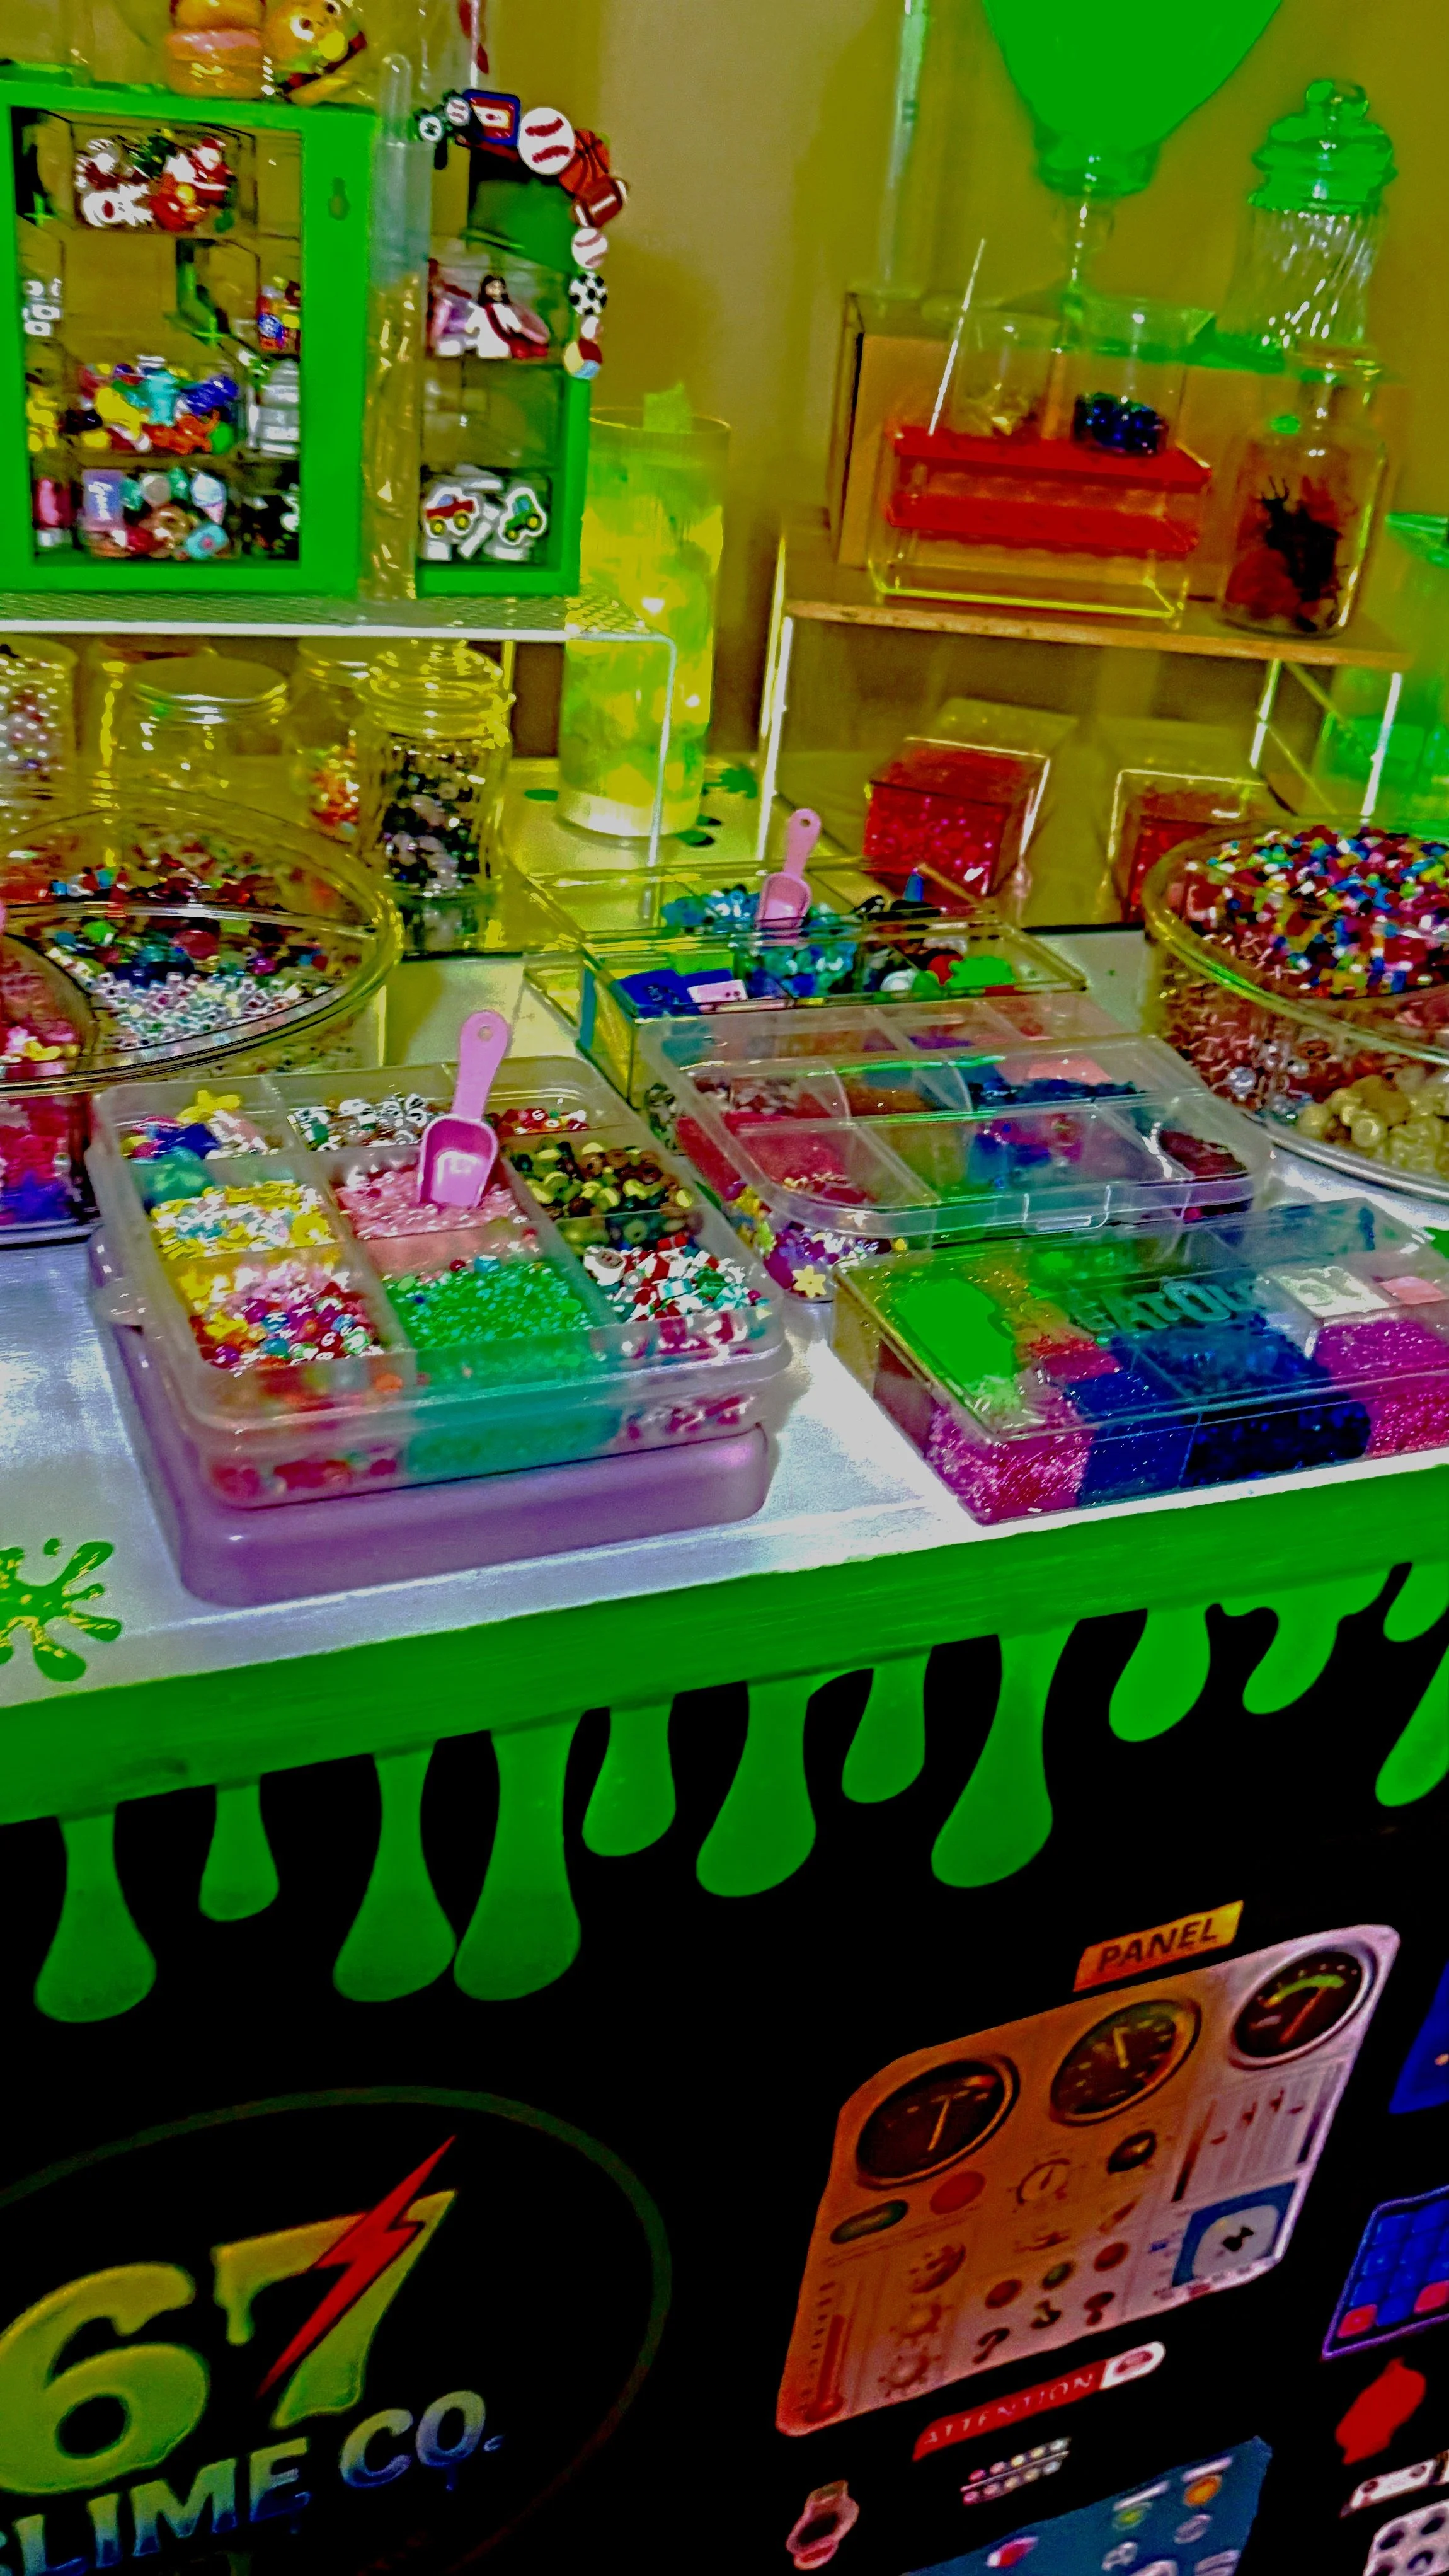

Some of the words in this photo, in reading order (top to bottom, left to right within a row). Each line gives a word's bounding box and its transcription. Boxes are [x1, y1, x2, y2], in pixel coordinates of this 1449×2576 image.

[1097, 1917, 1219, 1972] PANEL
[0, 2190, 459, 2495] 67
[925, 2373, 1095, 2445] ATTENTION
[0, 2436, 311, 2576] LIME
